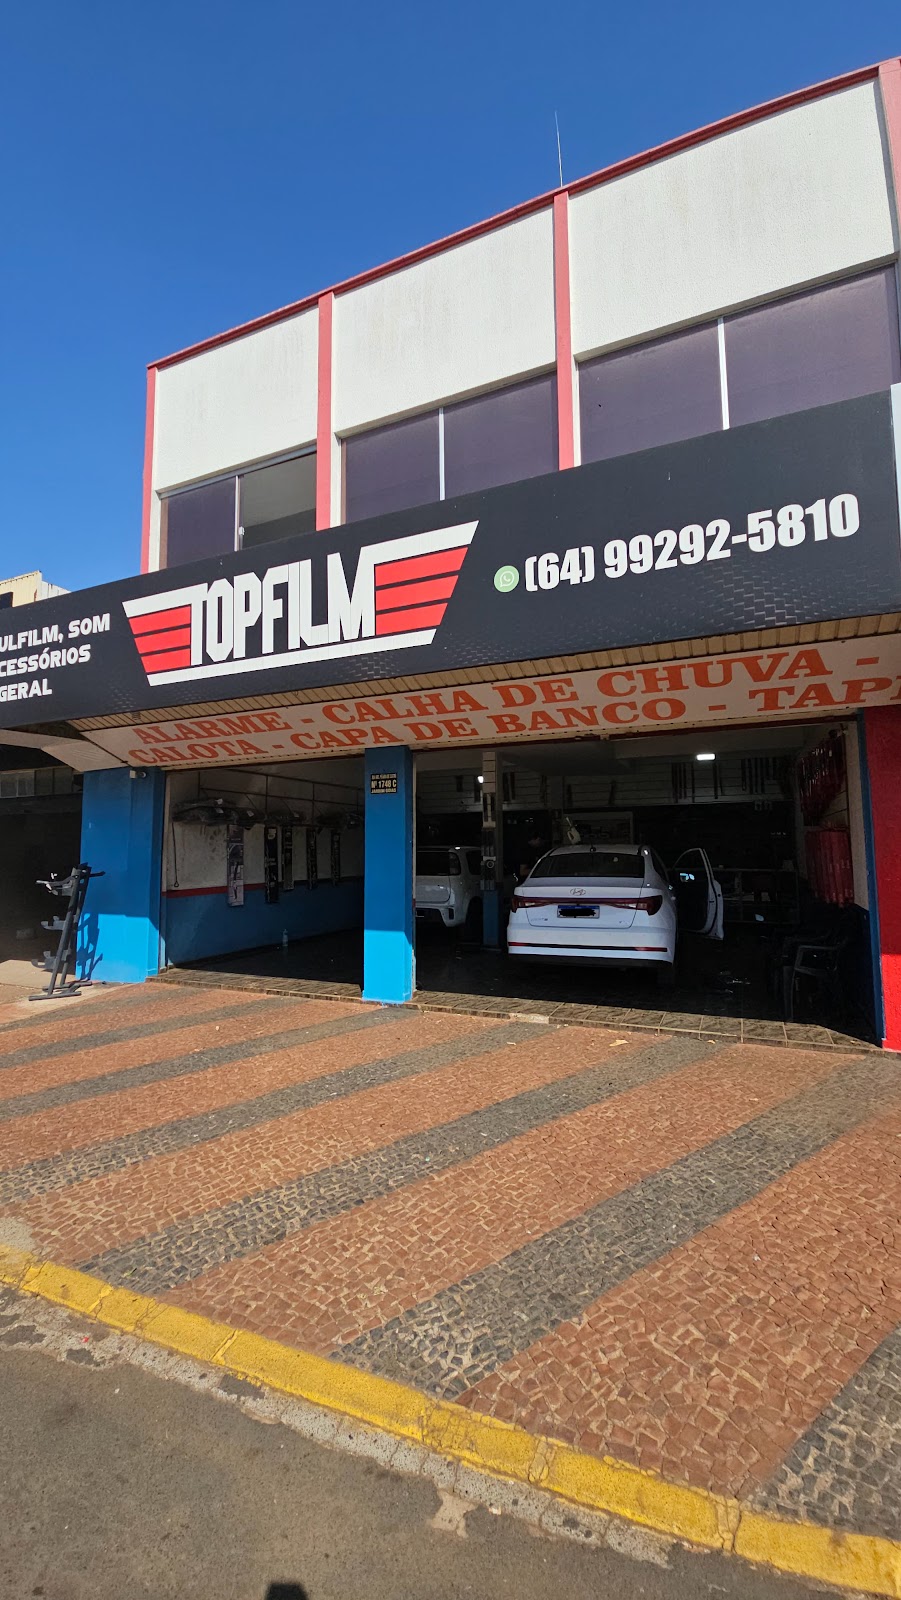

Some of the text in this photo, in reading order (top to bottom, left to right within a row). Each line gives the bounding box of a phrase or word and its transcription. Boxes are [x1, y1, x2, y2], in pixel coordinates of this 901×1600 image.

[524, 493, 860, 592] (64) 99292-5810
[67, 613, 111, 639] SOM
[0, 678, 53, 702] GERAL
[132, 711, 293, 745] ALARME
[322, 689, 488, 725] CALHA
[492, 677, 580, 708] DE
[597, 648, 833, 698] CHUVA
[128, 739, 269, 765] CALOTA
[290, 725, 405, 751] CAPA
[405, 717, 479, 742] DE
[488, 697, 687, 734] BANCO
